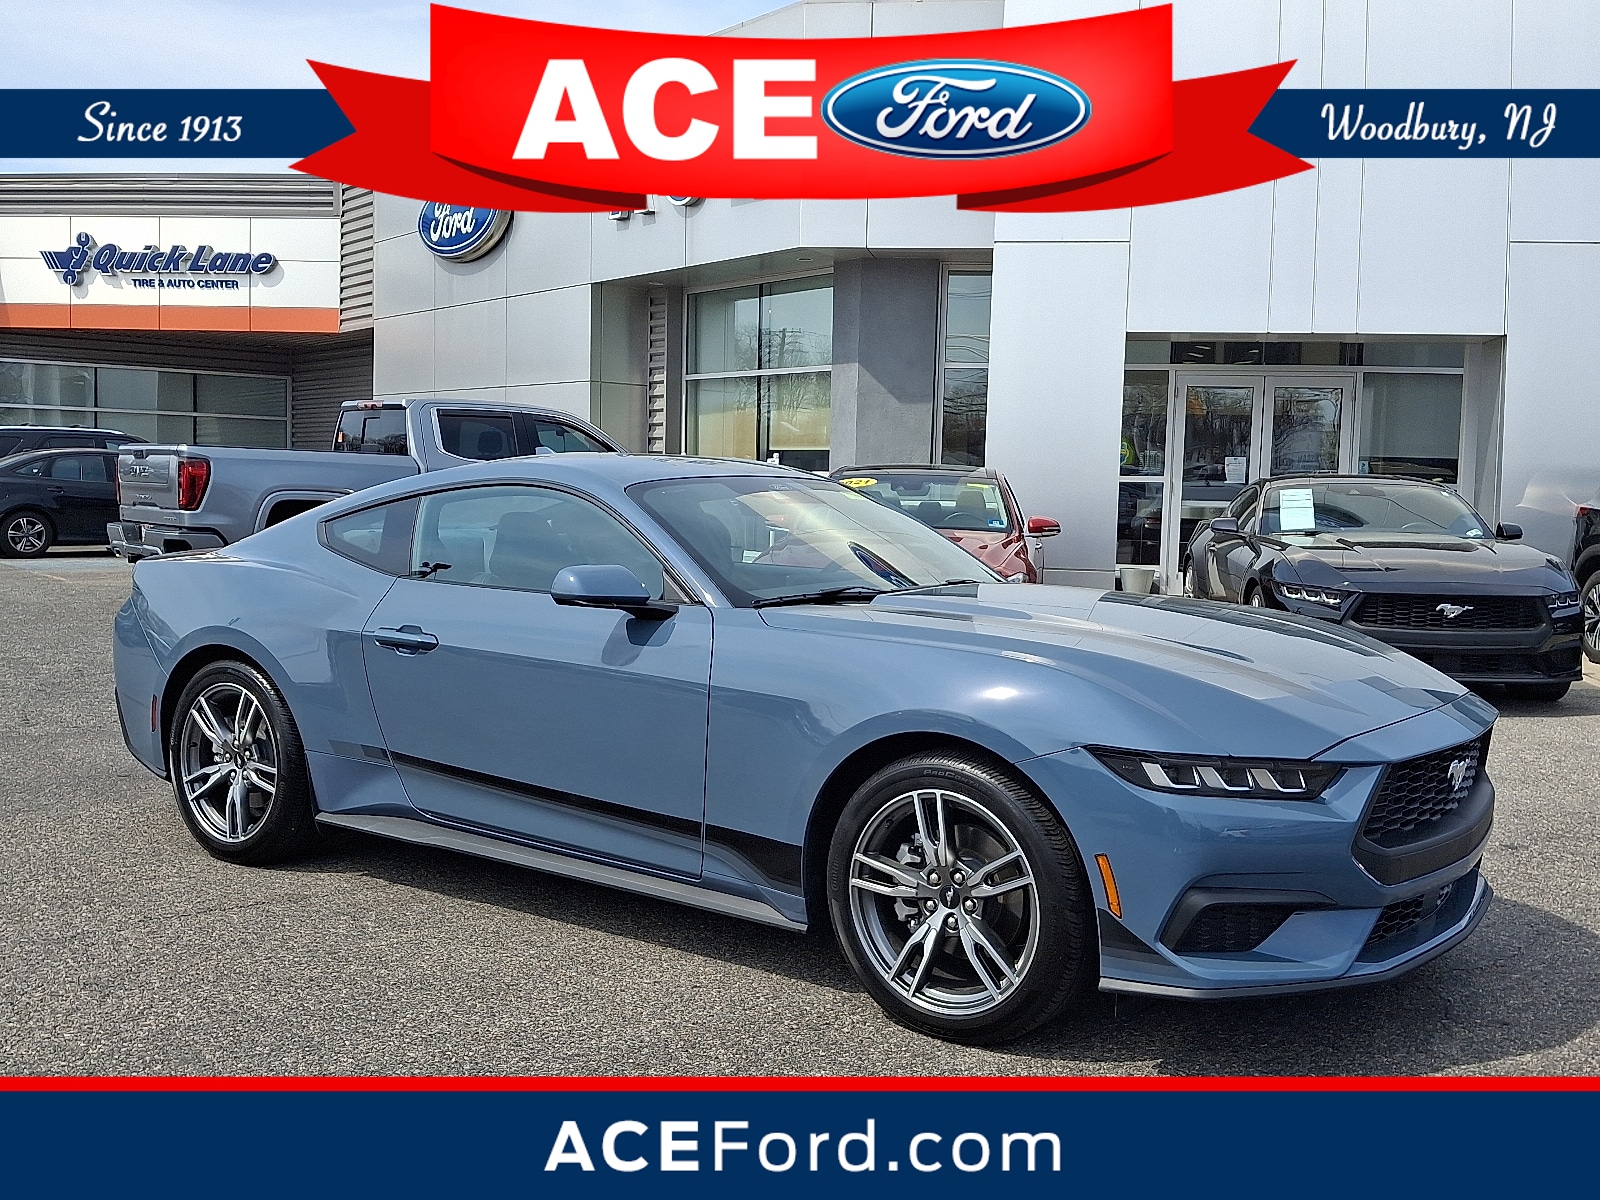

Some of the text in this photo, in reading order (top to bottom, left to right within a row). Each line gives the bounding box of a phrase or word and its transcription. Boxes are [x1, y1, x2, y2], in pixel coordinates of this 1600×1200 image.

[92, 243, 275, 276] Quick Lane
[131, 278, 240, 290] TIRE & AUTO CENTER
